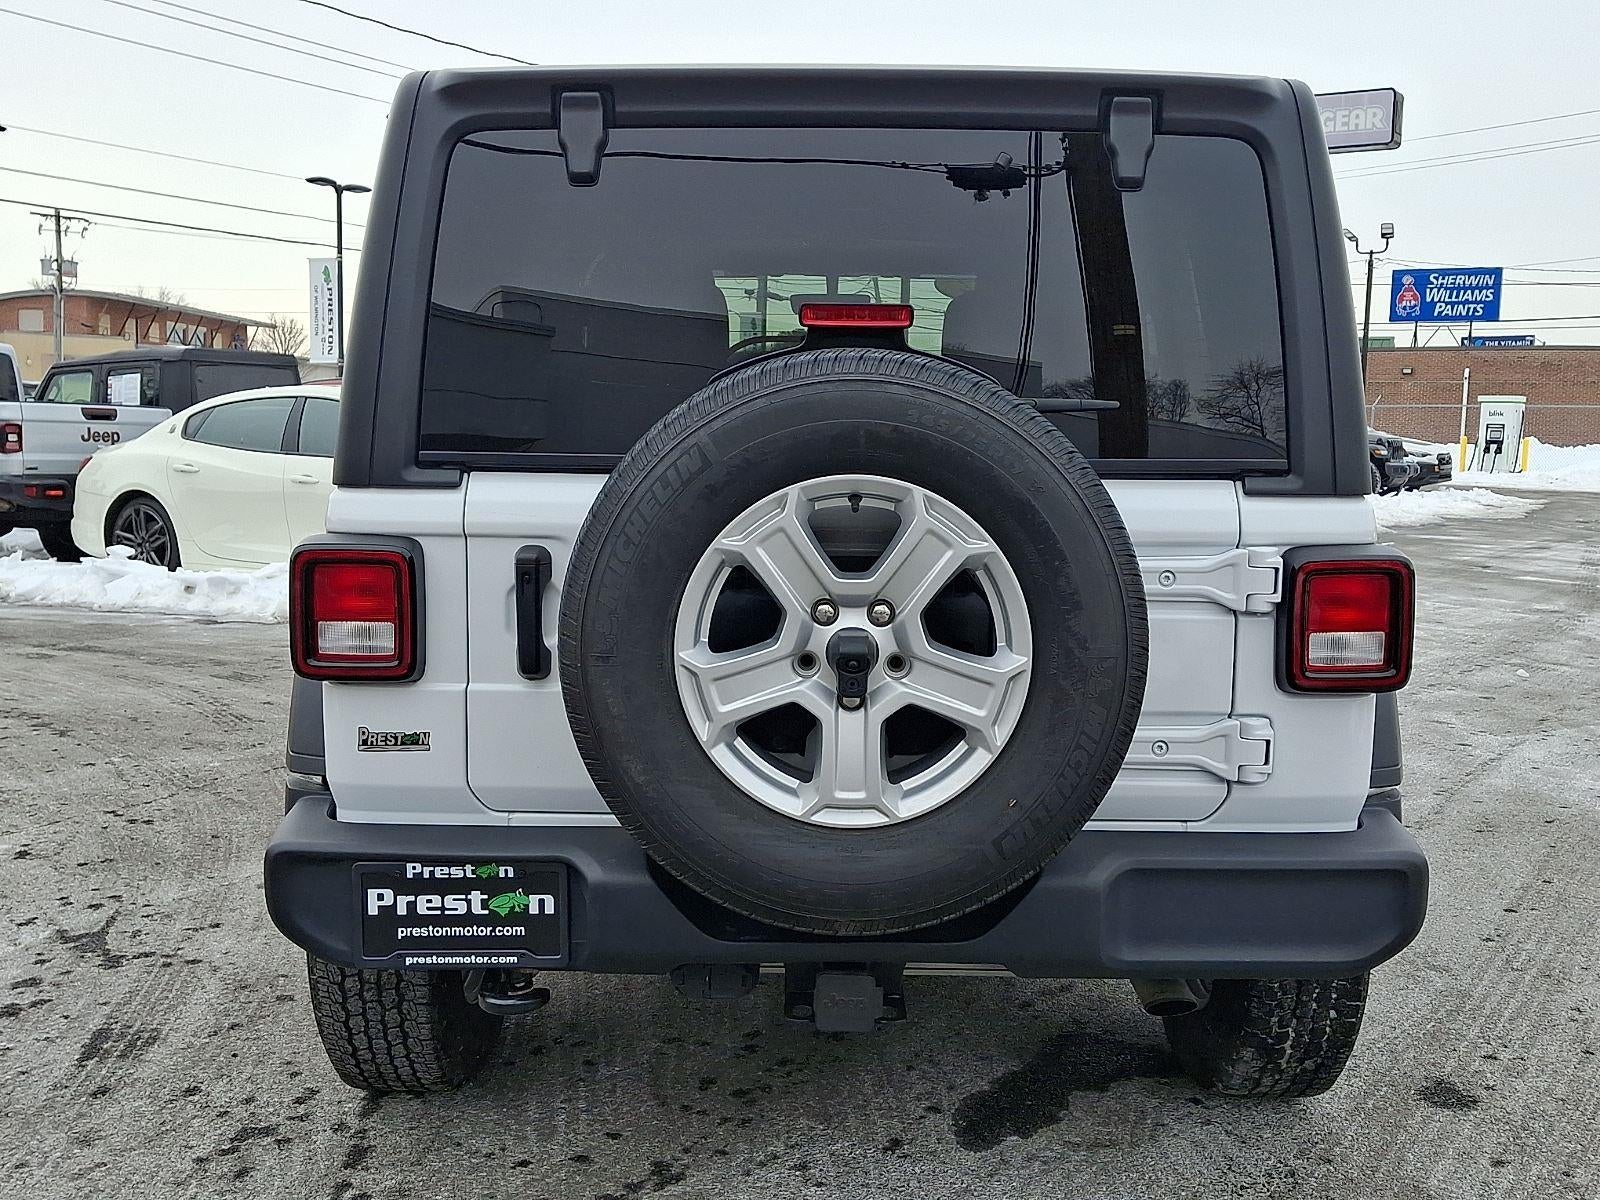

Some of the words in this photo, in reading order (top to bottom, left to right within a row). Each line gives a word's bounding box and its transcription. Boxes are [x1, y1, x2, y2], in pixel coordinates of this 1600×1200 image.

[1320, 106, 1388, 132] GEAR
[1427, 273, 1495, 288] SHERWIN
[313, 284, 319, 293] OF
[1425, 287, 1495, 302] WILLIAMS
[1433, 302, 1485, 317] PAINTS
[326, 287, 334, 355] PRESTON
[1500, 339, 1531, 347] VITAMIN
[1488, 409, 1505, 417] blink
[80, 426, 121, 446] Jeep
[599, 445, 705, 609] MICHELIN
[359, 727, 429, 746] PRESTN
[406, 862, 514, 879] Prestn
[367, 888, 555, 916] Prestn
[397, 925, 526, 939] prestonmotor.com
[405, 954, 518, 966] prestonmotor.com
